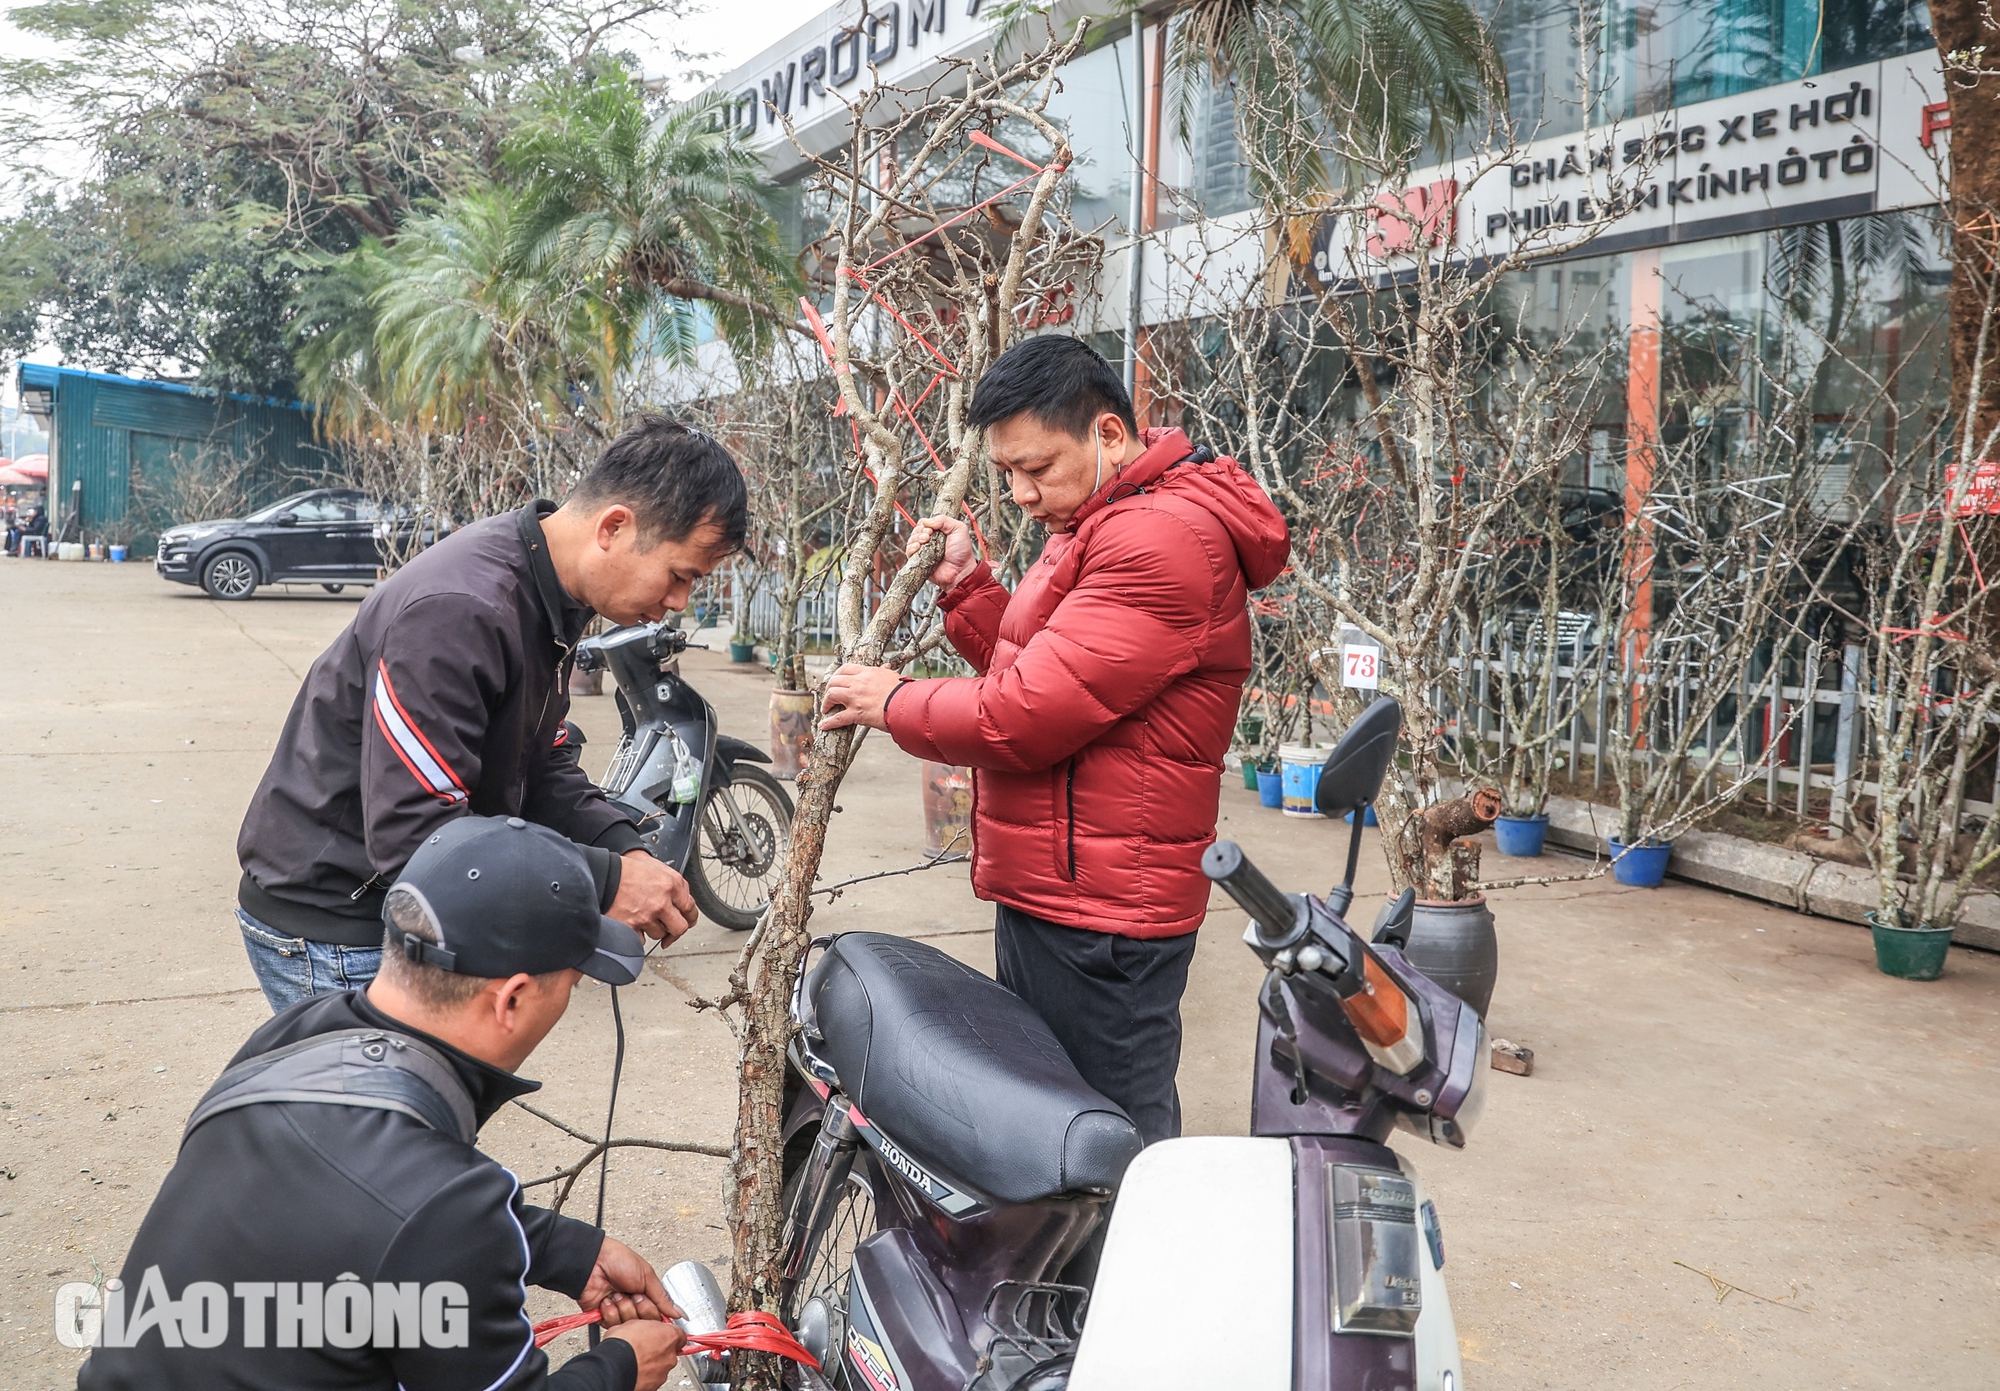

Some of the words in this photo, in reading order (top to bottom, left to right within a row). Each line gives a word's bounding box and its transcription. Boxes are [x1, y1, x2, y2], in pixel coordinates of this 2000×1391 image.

[706, 0, 945, 142] OWROOM
[1718, 108, 1777, 145] XE
[1790, 82, 1871, 130] HƠI
[1487, 200, 1568, 237] PHIM
[1668, 161, 1769, 206] KÍNH
[1347, 653, 1375, 678] 73
[879, 1137, 933, 1195] HONDA
[847, 1323, 900, 1391] DREA
